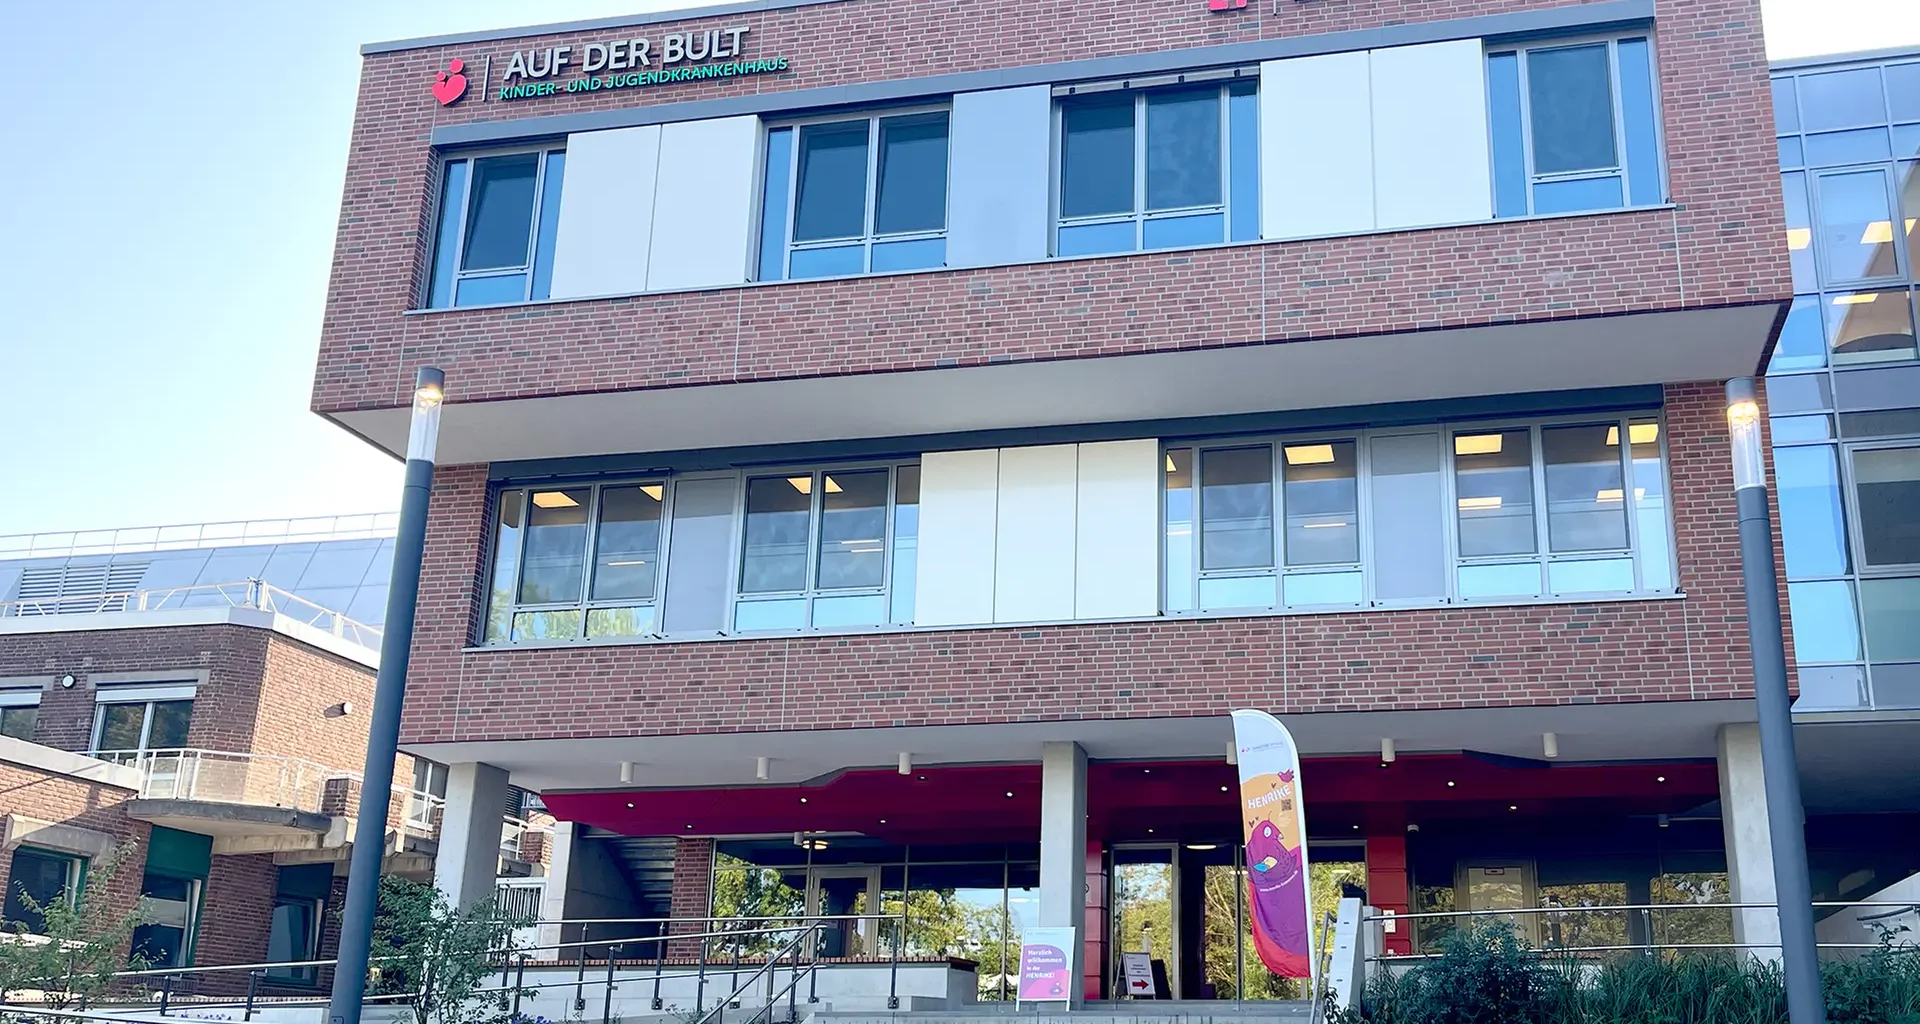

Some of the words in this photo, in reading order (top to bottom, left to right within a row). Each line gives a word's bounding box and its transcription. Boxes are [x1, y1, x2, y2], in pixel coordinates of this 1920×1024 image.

[503, 46, 571, 81] AUF
[582, 38, 651, 73] DER
[663, 26, 750, 64] BULT
[500, 82, 562, 100] KINDER-
[567, 77, 602, 93] UND
[605, 57, 788, 89] JUGENDKRANKENHAUS
[1248, 785, 1291, 809] HENRIKE
